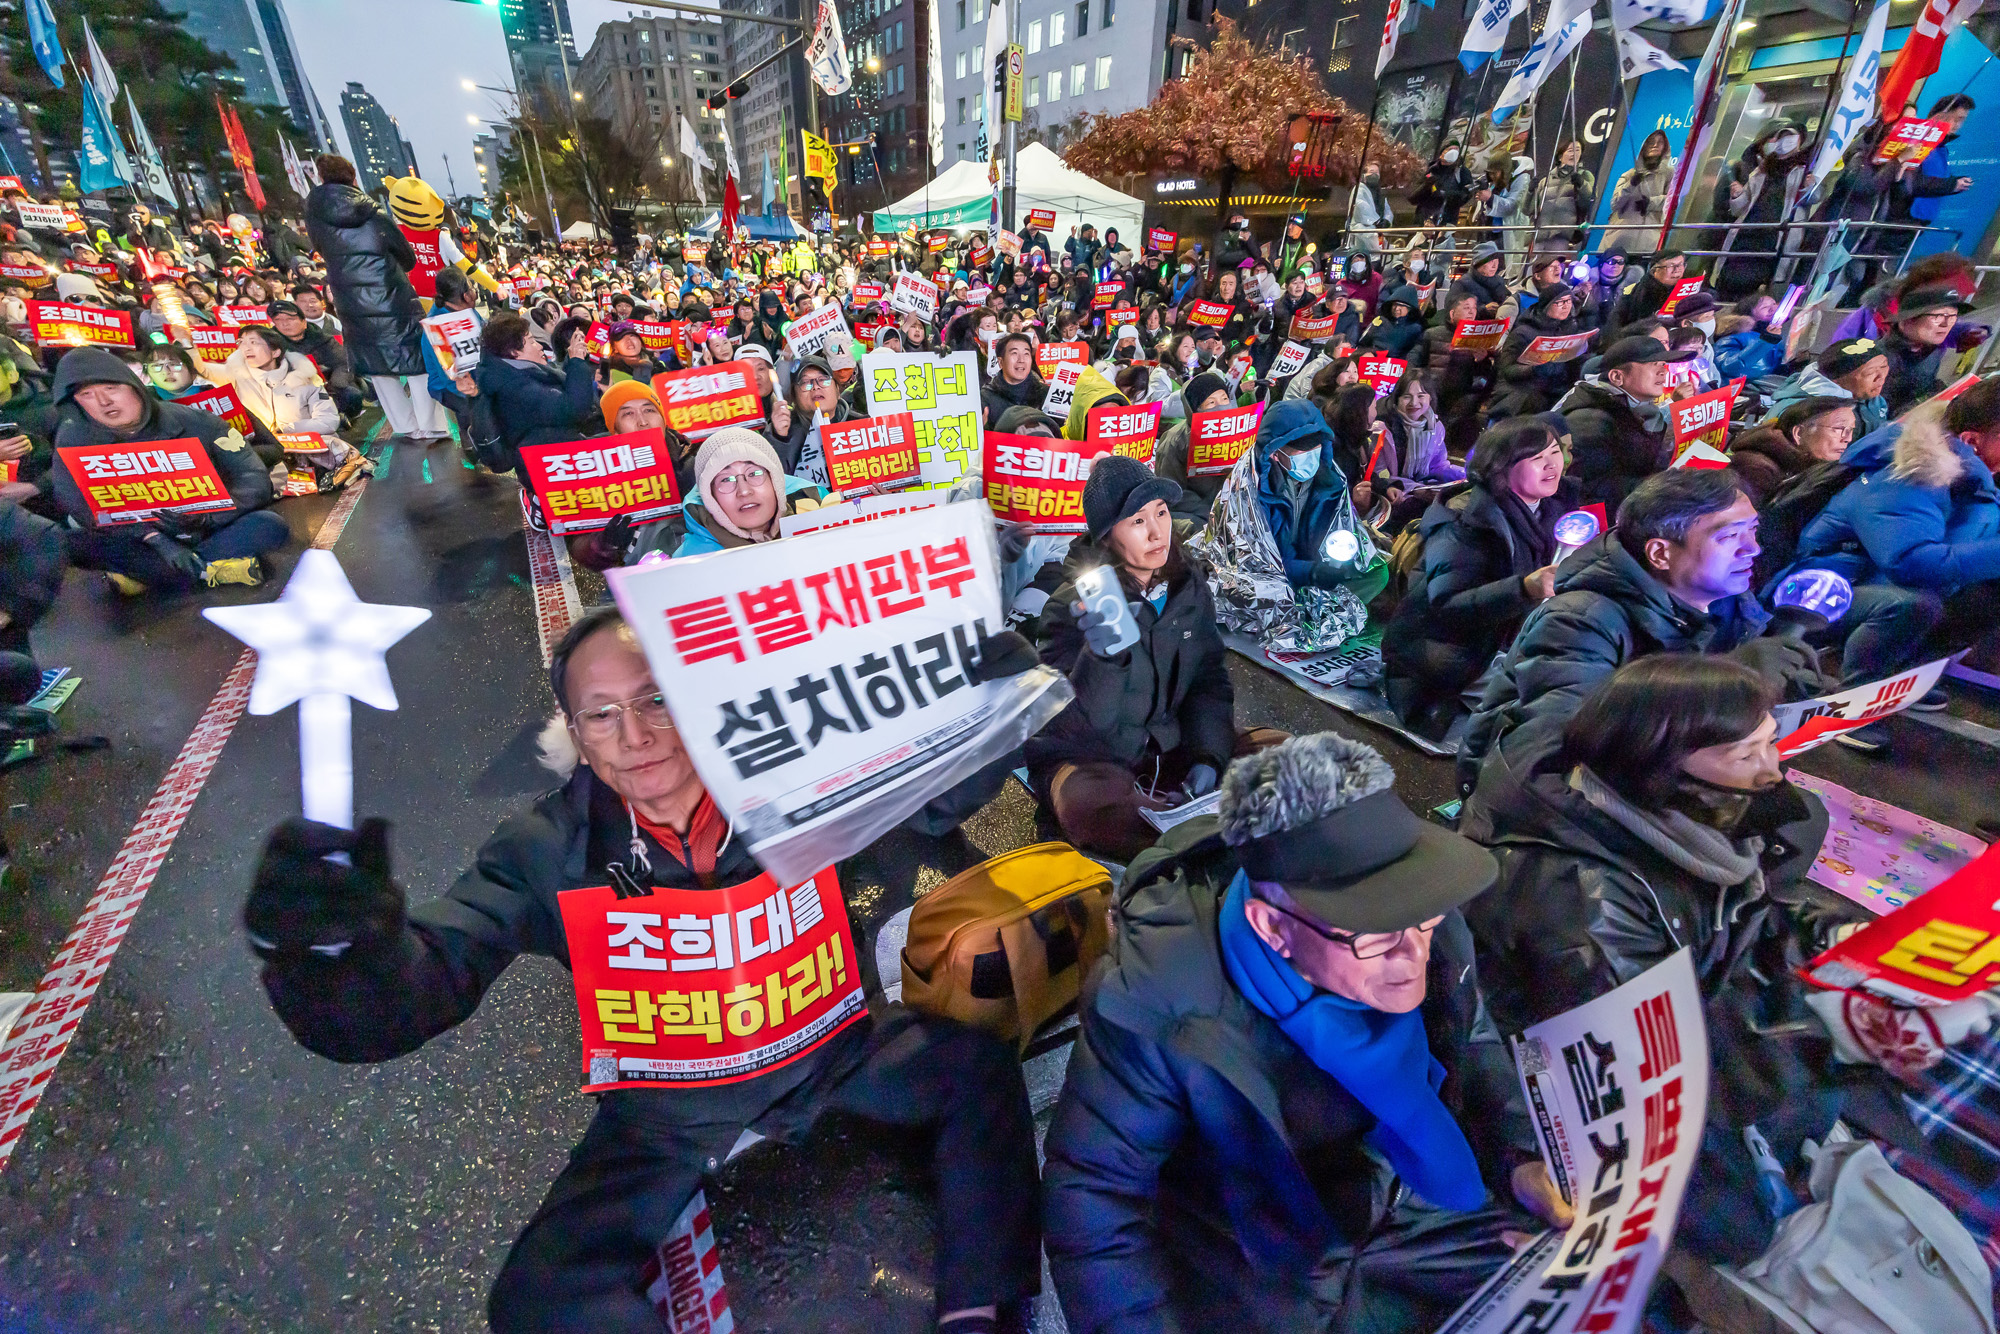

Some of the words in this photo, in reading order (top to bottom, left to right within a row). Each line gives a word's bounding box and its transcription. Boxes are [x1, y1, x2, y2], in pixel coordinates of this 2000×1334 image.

[1494, 58, 1520, 69] GREETS
[1407, 75, 1425, 85] GLAD
[1157, 180, 1175, 192] GLAD
[1176, 179, 1197, 191] HOTEL
[1151, 231, 1174, 241] 조희대를
[1097, 283, 1123, 294] 조희대를
[1677, 280, 1702, 297] 조희
[38, 305, 121, 328] 조희대를
[711, 306, 734, 318] 조희대
[1191, 312, 1226, 328] 탄핵하라!
[1197, 302, 1229, 316] 조희대를
[192, 331, 236, 345] 희대를
[634, 323, 672, 336] 조희대를
[788, 308, 839, 340] 특별재판부
[1460, 322, 1505, 337] 조희대를
[642, 337, 674, 349] 핵하라!
[837, 344, 845, 355] A
[1040, 346, 1080, 361] 조희대를
[1539, 337, 1582, 352] 조희대
[1363, 361, 1405, 378] 조희대
[664, 370, 748, 403] 조희대를
[873, 362, 968, 411] 조희대
[668, 394, 758, 431] 탄핵하라!
[1099, 411, 1156, 439] 조희대를
[1200, 411, 1258, 439] 조희대를
[1678, 398, 1727, 435] 조희대를
[830, 424, 905, 456] 조희대를
[1113, 435, 1155, 461] 핵하라!
[79, 450, 197, 480] 조희대를
[541, 444, 657, 483] 조희대를
[832, 449, 916, 487] 탄핵하라!
[88, 475, 220, 509] 탄핵하라!
[546, 473, 673, 517] 탄핵하라!
[987, 481, 1085, 518] 탄핵하라
[664, 536, 977, 667] 특별재판부
[1299, 646, 1380, 678] 설치하라!
[713, 618, 992, 781] 설치하라
[66, 909, 121, 967] DANGER!
[605, 877, 826, 973] 조희대를
[594, 930, 848, 1045] 탄핵하라!
[31, 993, 76, 1029] 위험
[648, 1060, 686, 1071] 내란청산!
[687, 1055, 745, 1071] 국민주권실현!
[746, 1032, 804, 1061] 촛불대행진으로
[805, 1015, 828, 1036] 모이자!
[761, 1056, 775, 1066] ARS
[1572, 990, 1683, 1334] 특별재판
[1500, 1031, 1630, 1334] 설치하
